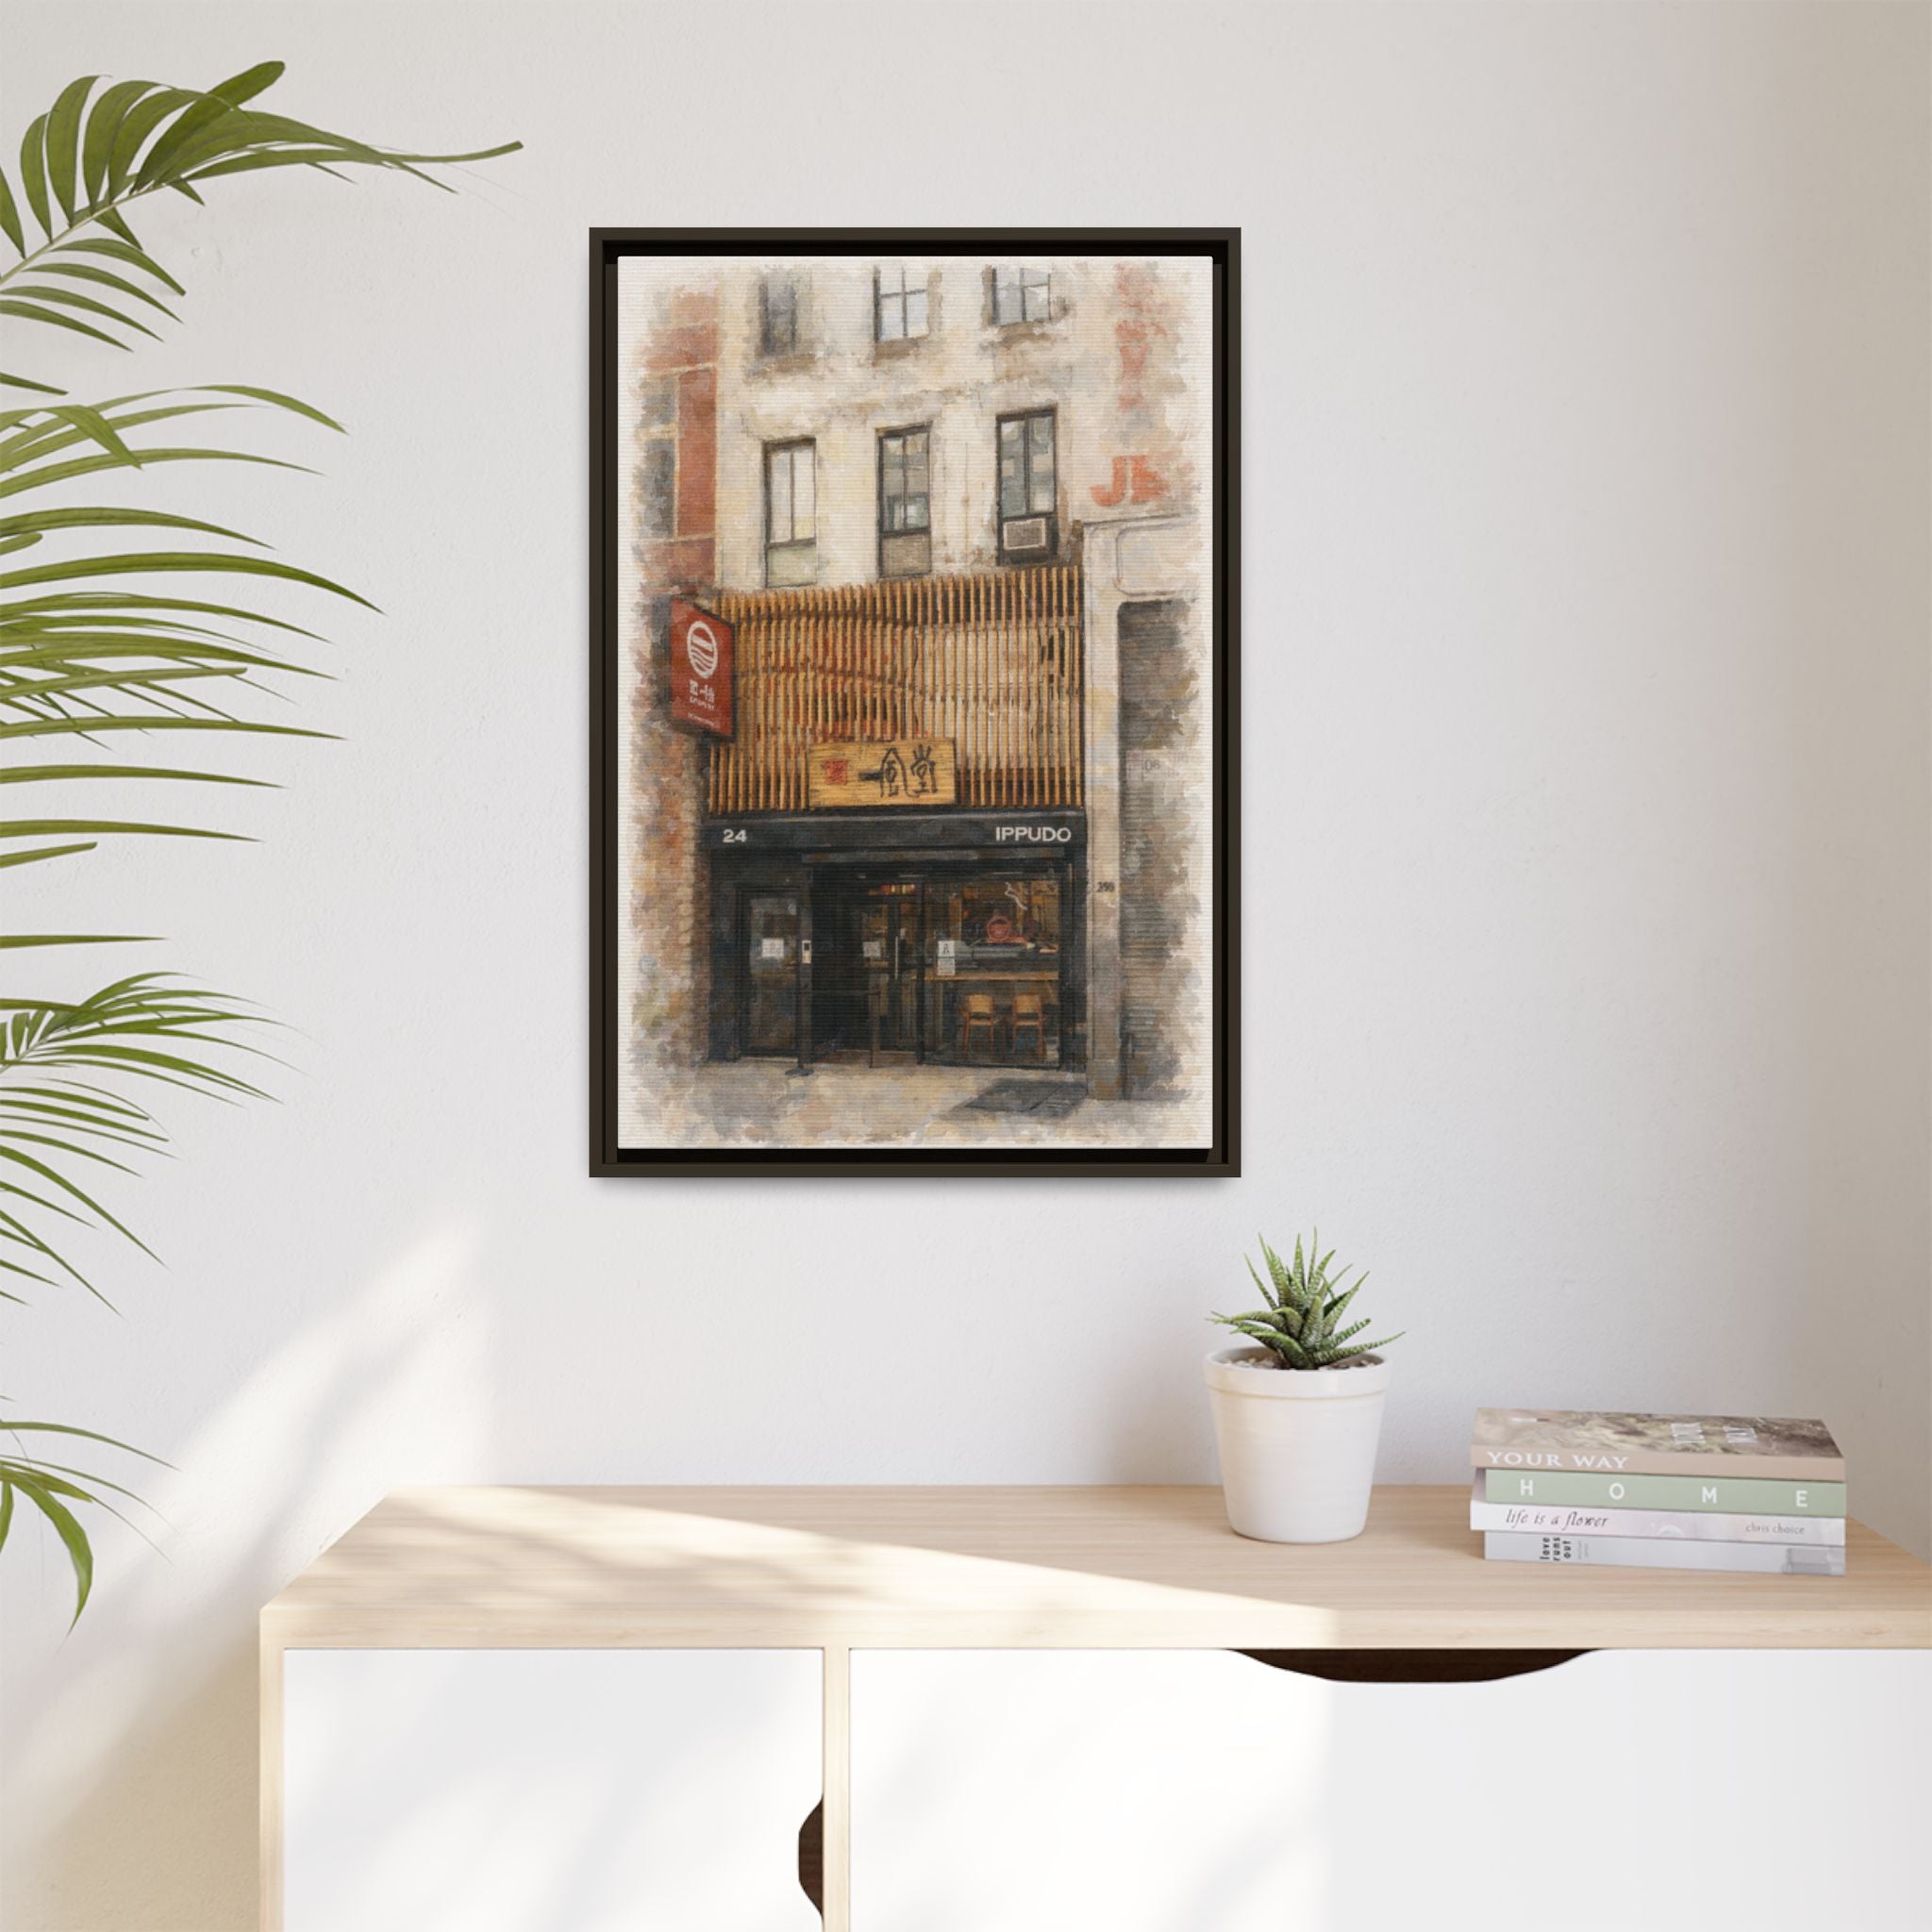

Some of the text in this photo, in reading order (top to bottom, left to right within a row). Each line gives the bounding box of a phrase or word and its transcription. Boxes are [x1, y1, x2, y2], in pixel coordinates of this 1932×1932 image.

[723, 828, 747, 843] 24
[995, 826, 1072, 842] IPPUDO
[1487, 1451, 1629, 1469] YOUR WAY
[1506, 1508, 1607, 1530] life is a flower
[1745, 1522, 1769, 1533] chris
[1539, 1537, 1550, 1559] love
